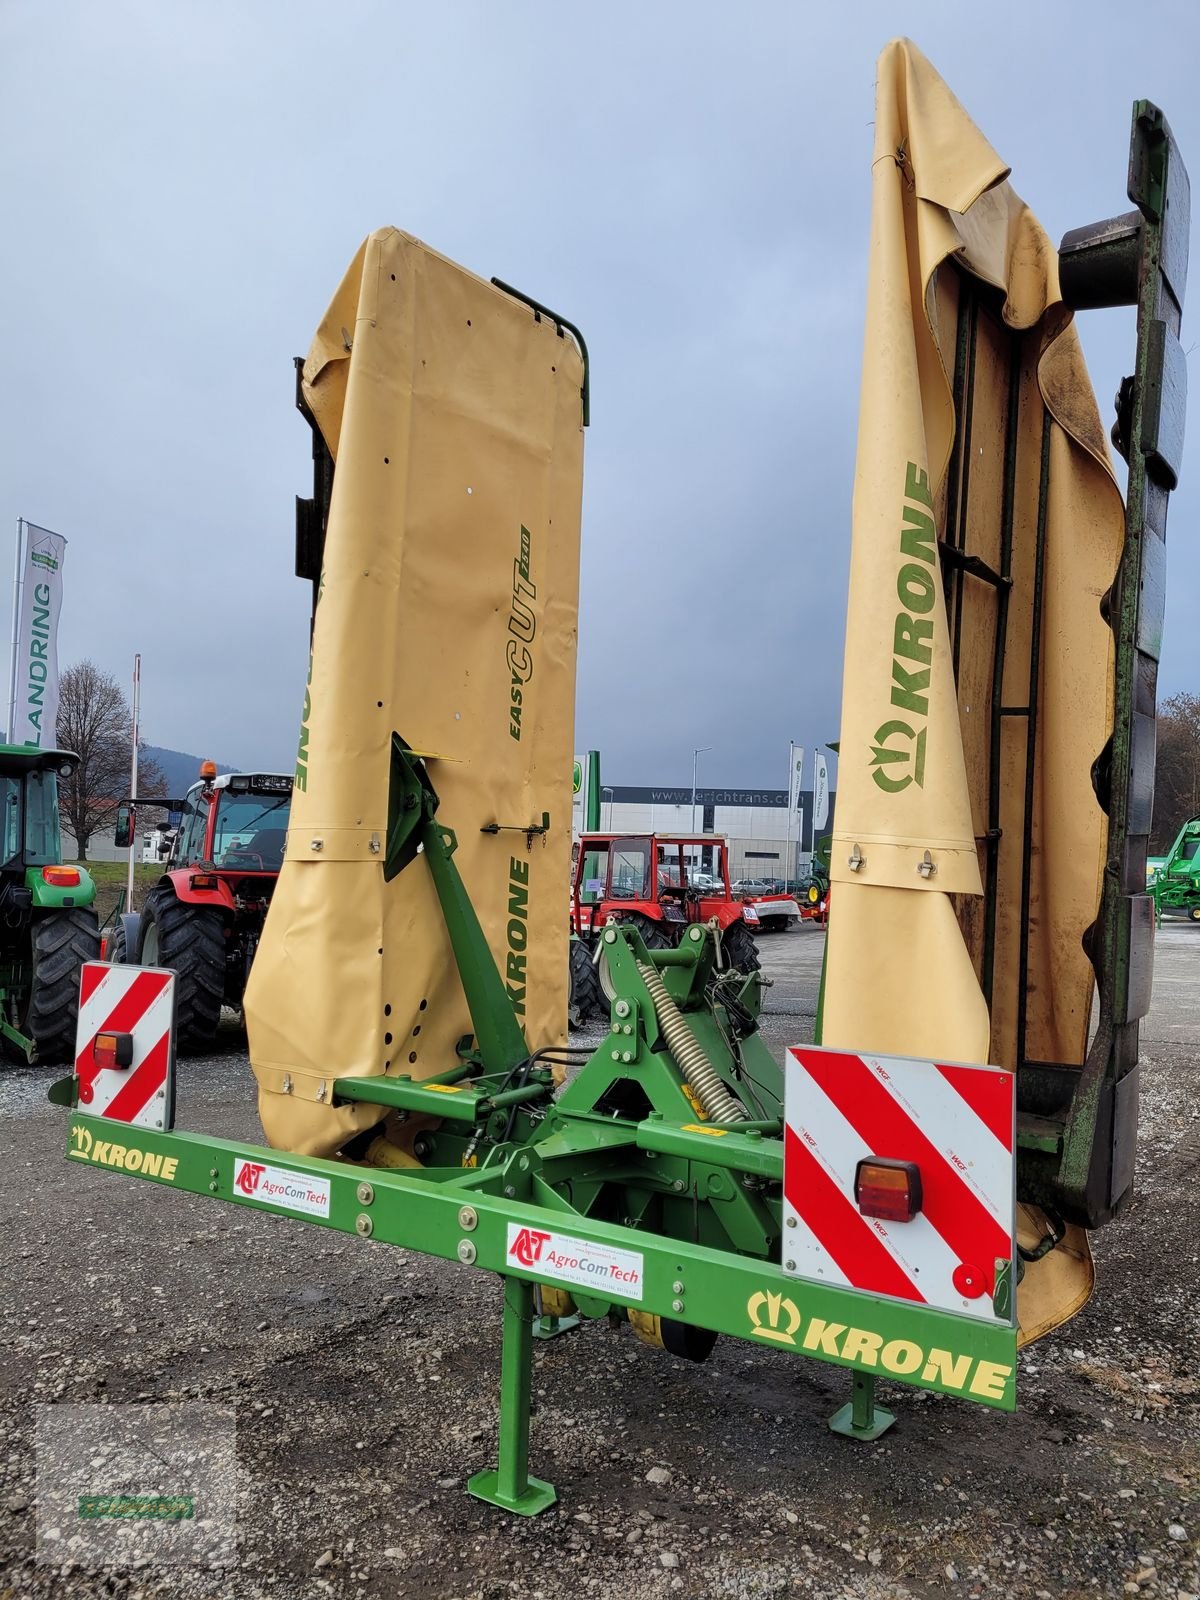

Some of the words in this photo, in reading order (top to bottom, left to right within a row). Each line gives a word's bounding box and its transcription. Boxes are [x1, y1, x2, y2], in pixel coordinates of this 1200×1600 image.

[520, 535, 530, 575] 7540
[890, 461, 936, 717] KRONE
[24, 583, 50, 748] LANDRING
[651, 788, 804, 806] www.jerichtrans.co
[505, 855, 530, 1016] KRONE
[876, 1066, 891, 1081] WGF
[803, 1131, 818, 1147] WGF
[92, 1141, 179, 1181] KRONE
[952, 1155, 967, 1171] WGF
[261, 1179, 328, 1205] AgroComTech
[874, 1220, 888, 1238] WGF
[546, 1250, 639, 1283] AgroComTech
[802, 1317, 1013, 1401] KRONE
